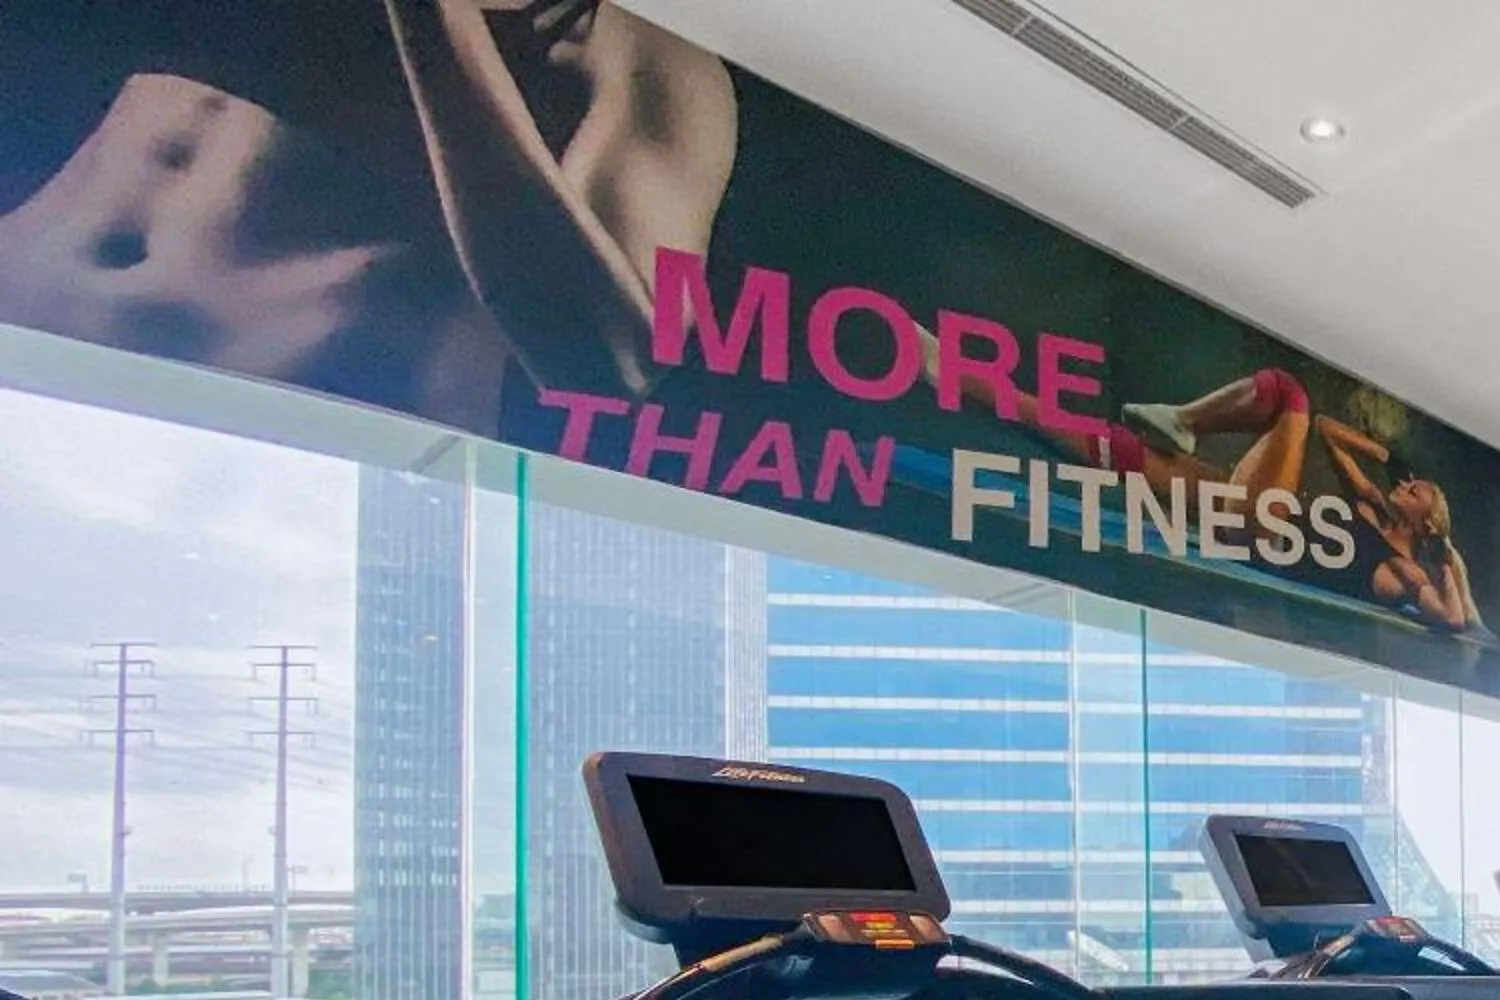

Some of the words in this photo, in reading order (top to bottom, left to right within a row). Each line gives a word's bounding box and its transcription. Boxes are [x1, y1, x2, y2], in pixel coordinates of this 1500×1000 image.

[652, 245, 1111, 438] MORE
[536, 388, 897, 508] THAN
[950, 447, 1356, 570] FITNESS
